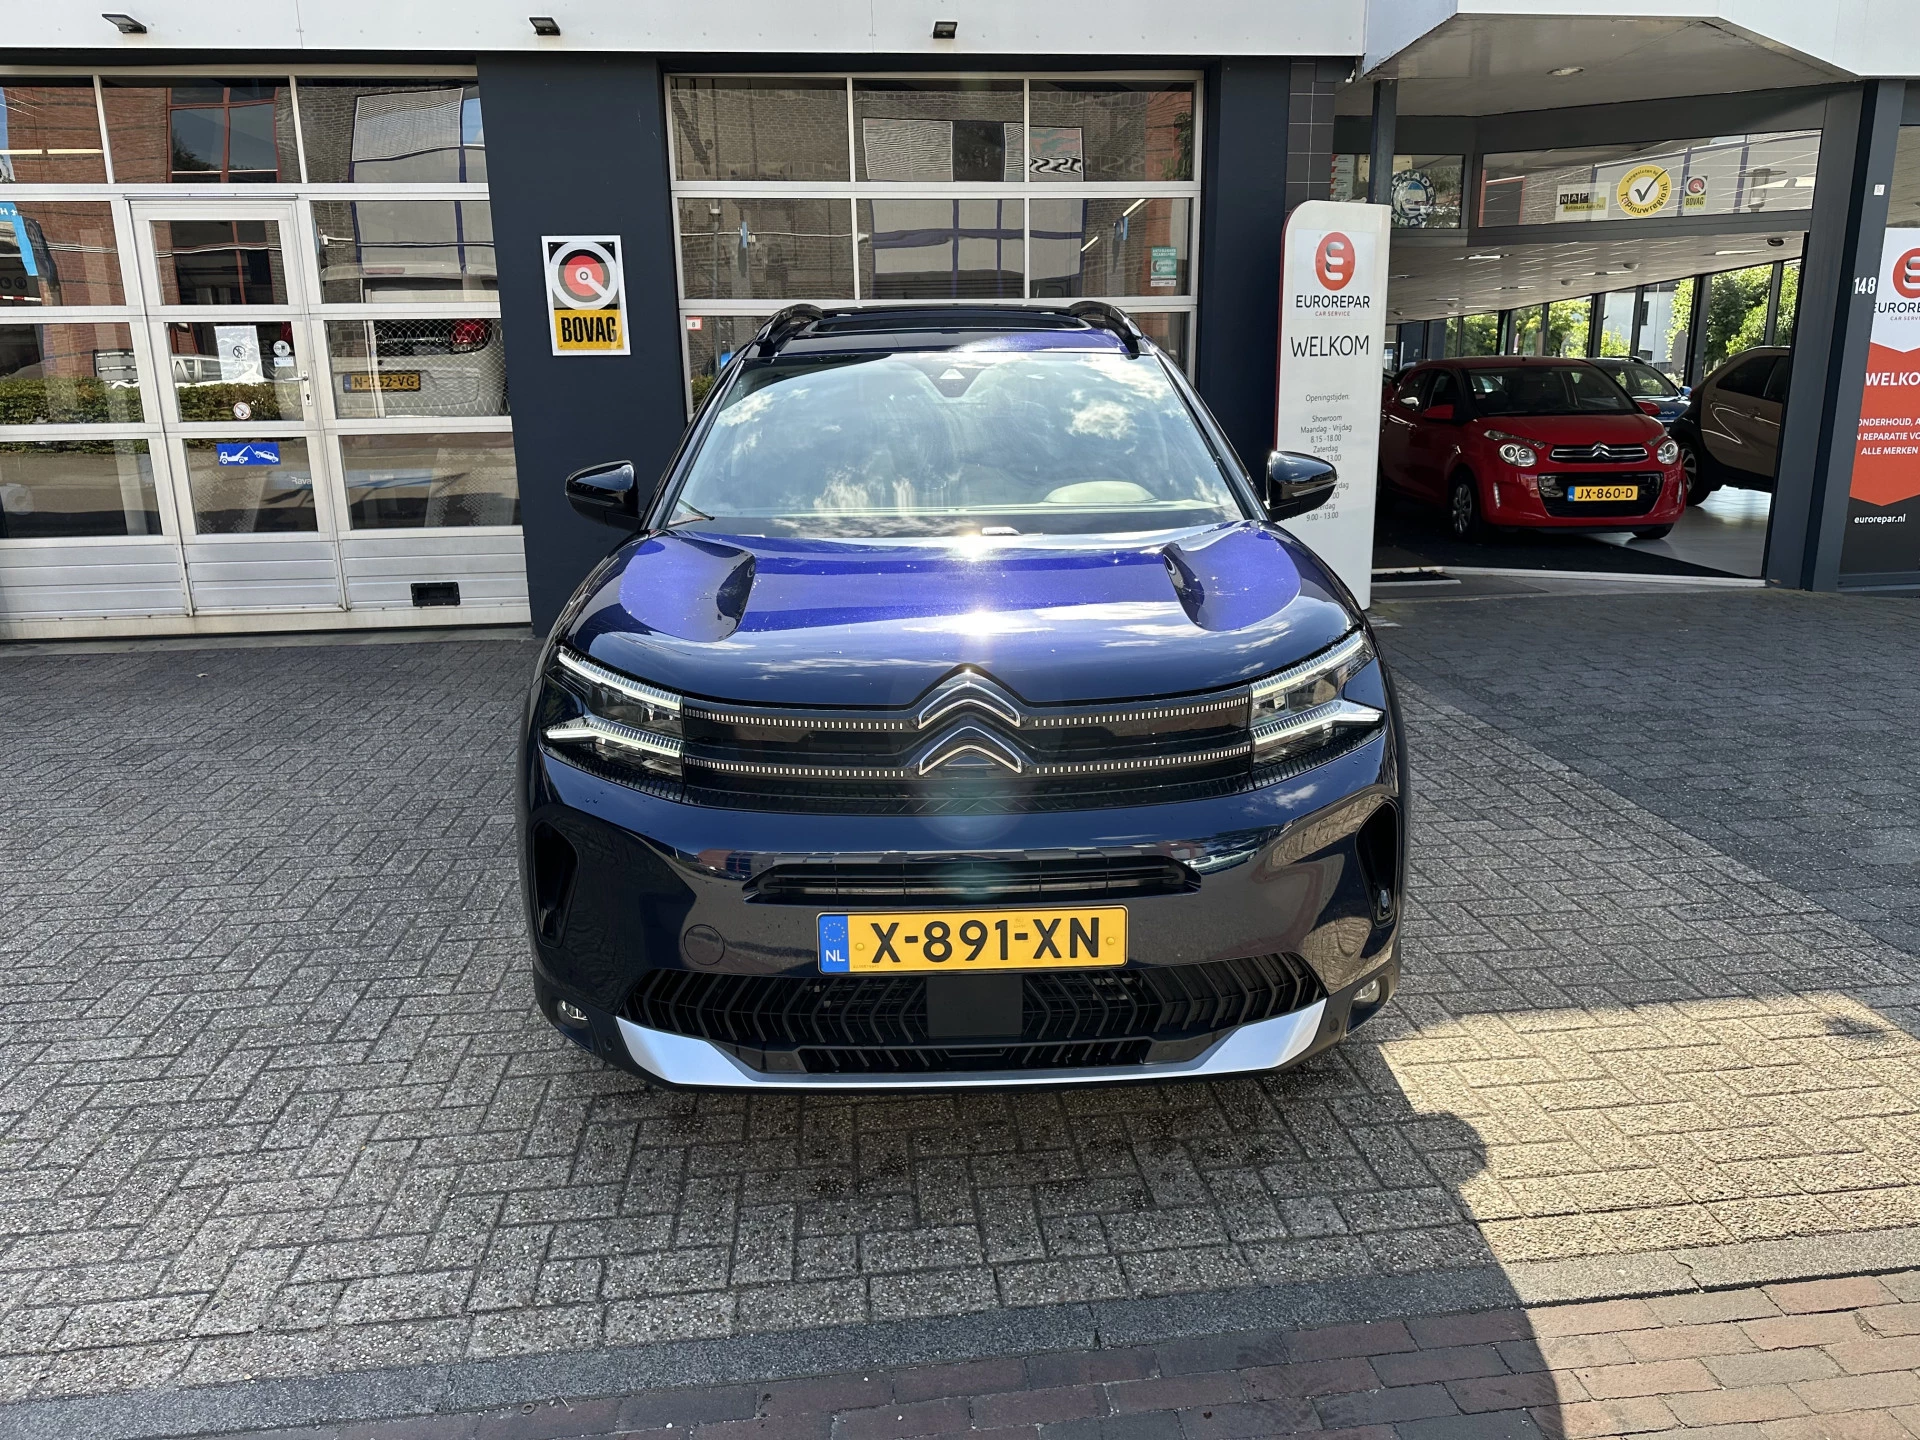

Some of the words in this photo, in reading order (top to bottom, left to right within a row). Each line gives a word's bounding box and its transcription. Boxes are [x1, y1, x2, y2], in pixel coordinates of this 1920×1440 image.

[1561, 193, 1588, 203] NAP
[1685, 197, 1705, 206] BOVAG
[1854, 276, 1877, 295] 148
[1295, 294, 1371, 309] EUROREPAR
[560, 316, 618, 343] BOVAG
[1290, 334, 1370, 358] WELKOM
[1311, 415, 1342, 423] Showroom
[1300, 426, 1328, 434] Maandag
[1332, 424, 1353, 433] Vrijdag
[1863, 432, 1908, 441] REPARATIE
[1313, 445, 1339, 454] Zaterdag
[1861, 447, 1881, 455] ALLE
[1882, 447, 1919, 455] MERKEN
[1577, 488, 1634, 499] JX-860-D
[1324, 512, 1339, 520] 13.00
[1854, 514, 1907, 525] eurorepar.nl
[825, 950, 845, 962] NL
[870, 917, 1100, 964] X-891-XN
